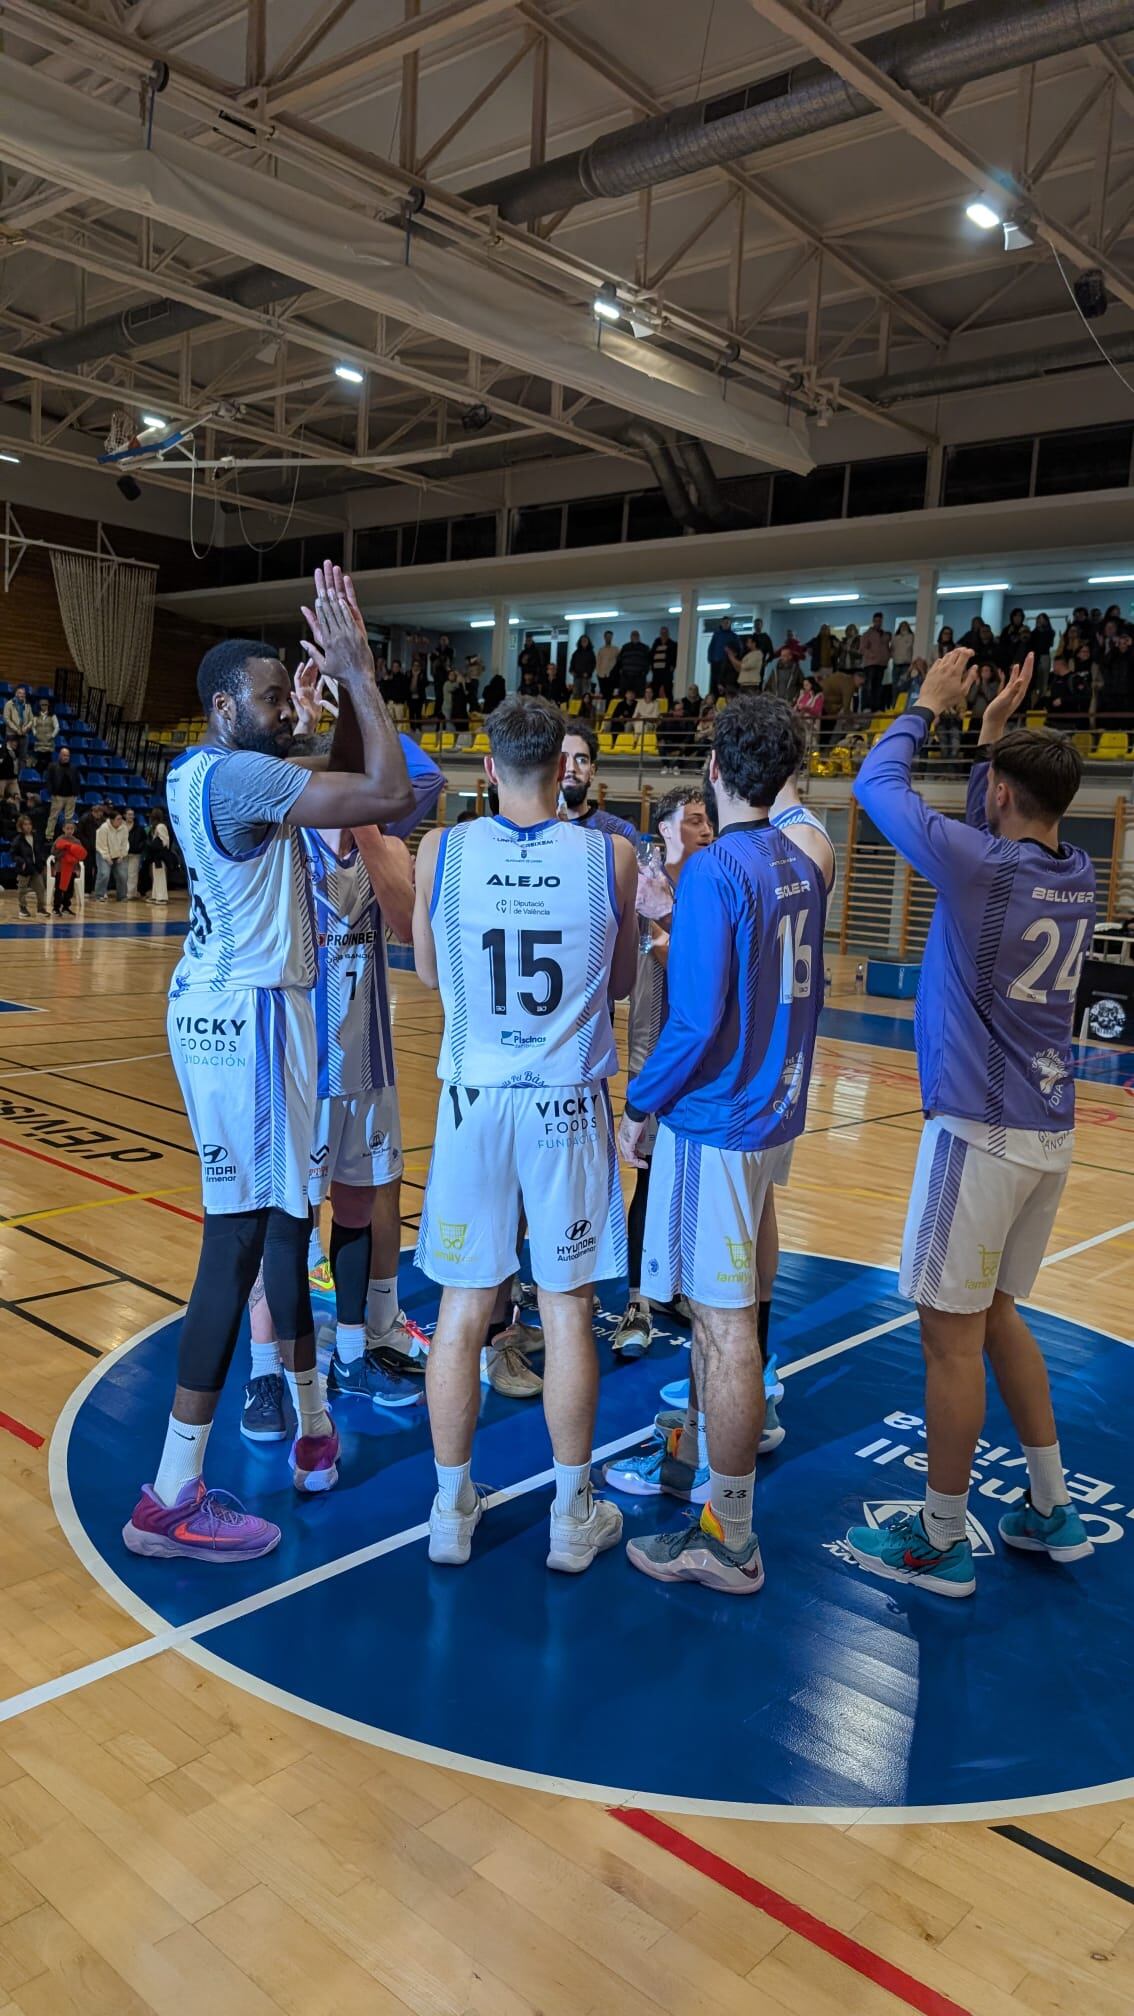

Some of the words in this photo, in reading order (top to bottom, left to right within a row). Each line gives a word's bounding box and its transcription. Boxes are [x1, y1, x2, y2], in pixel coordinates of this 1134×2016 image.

[486, 874, 561, 888] ALEJO
[513, 899, 545, 908] Diputació
[1031, 886, 1095, 903] BELLVER
[326, 930, 377, 947] PROINBE
[777, 909, 813, 1005] 16
[1006, 917, 1089, 1005] 24
[482, 928, 563, 1017] 15
[345, 971, 358, 1001] 7
[176, 1016, 247, 1036] VICKY
[180, 1038, 237, 1053] FOODS
[183, 1053, 246, 1067] UNDACIÓN
[536, 1094, 599, 1119] VICKY
[545, 1116, 597, 1136] FOODS
[556, 1237, 597, 1255] HYUNDAI
[723, 1489, 748, 1499] 23
